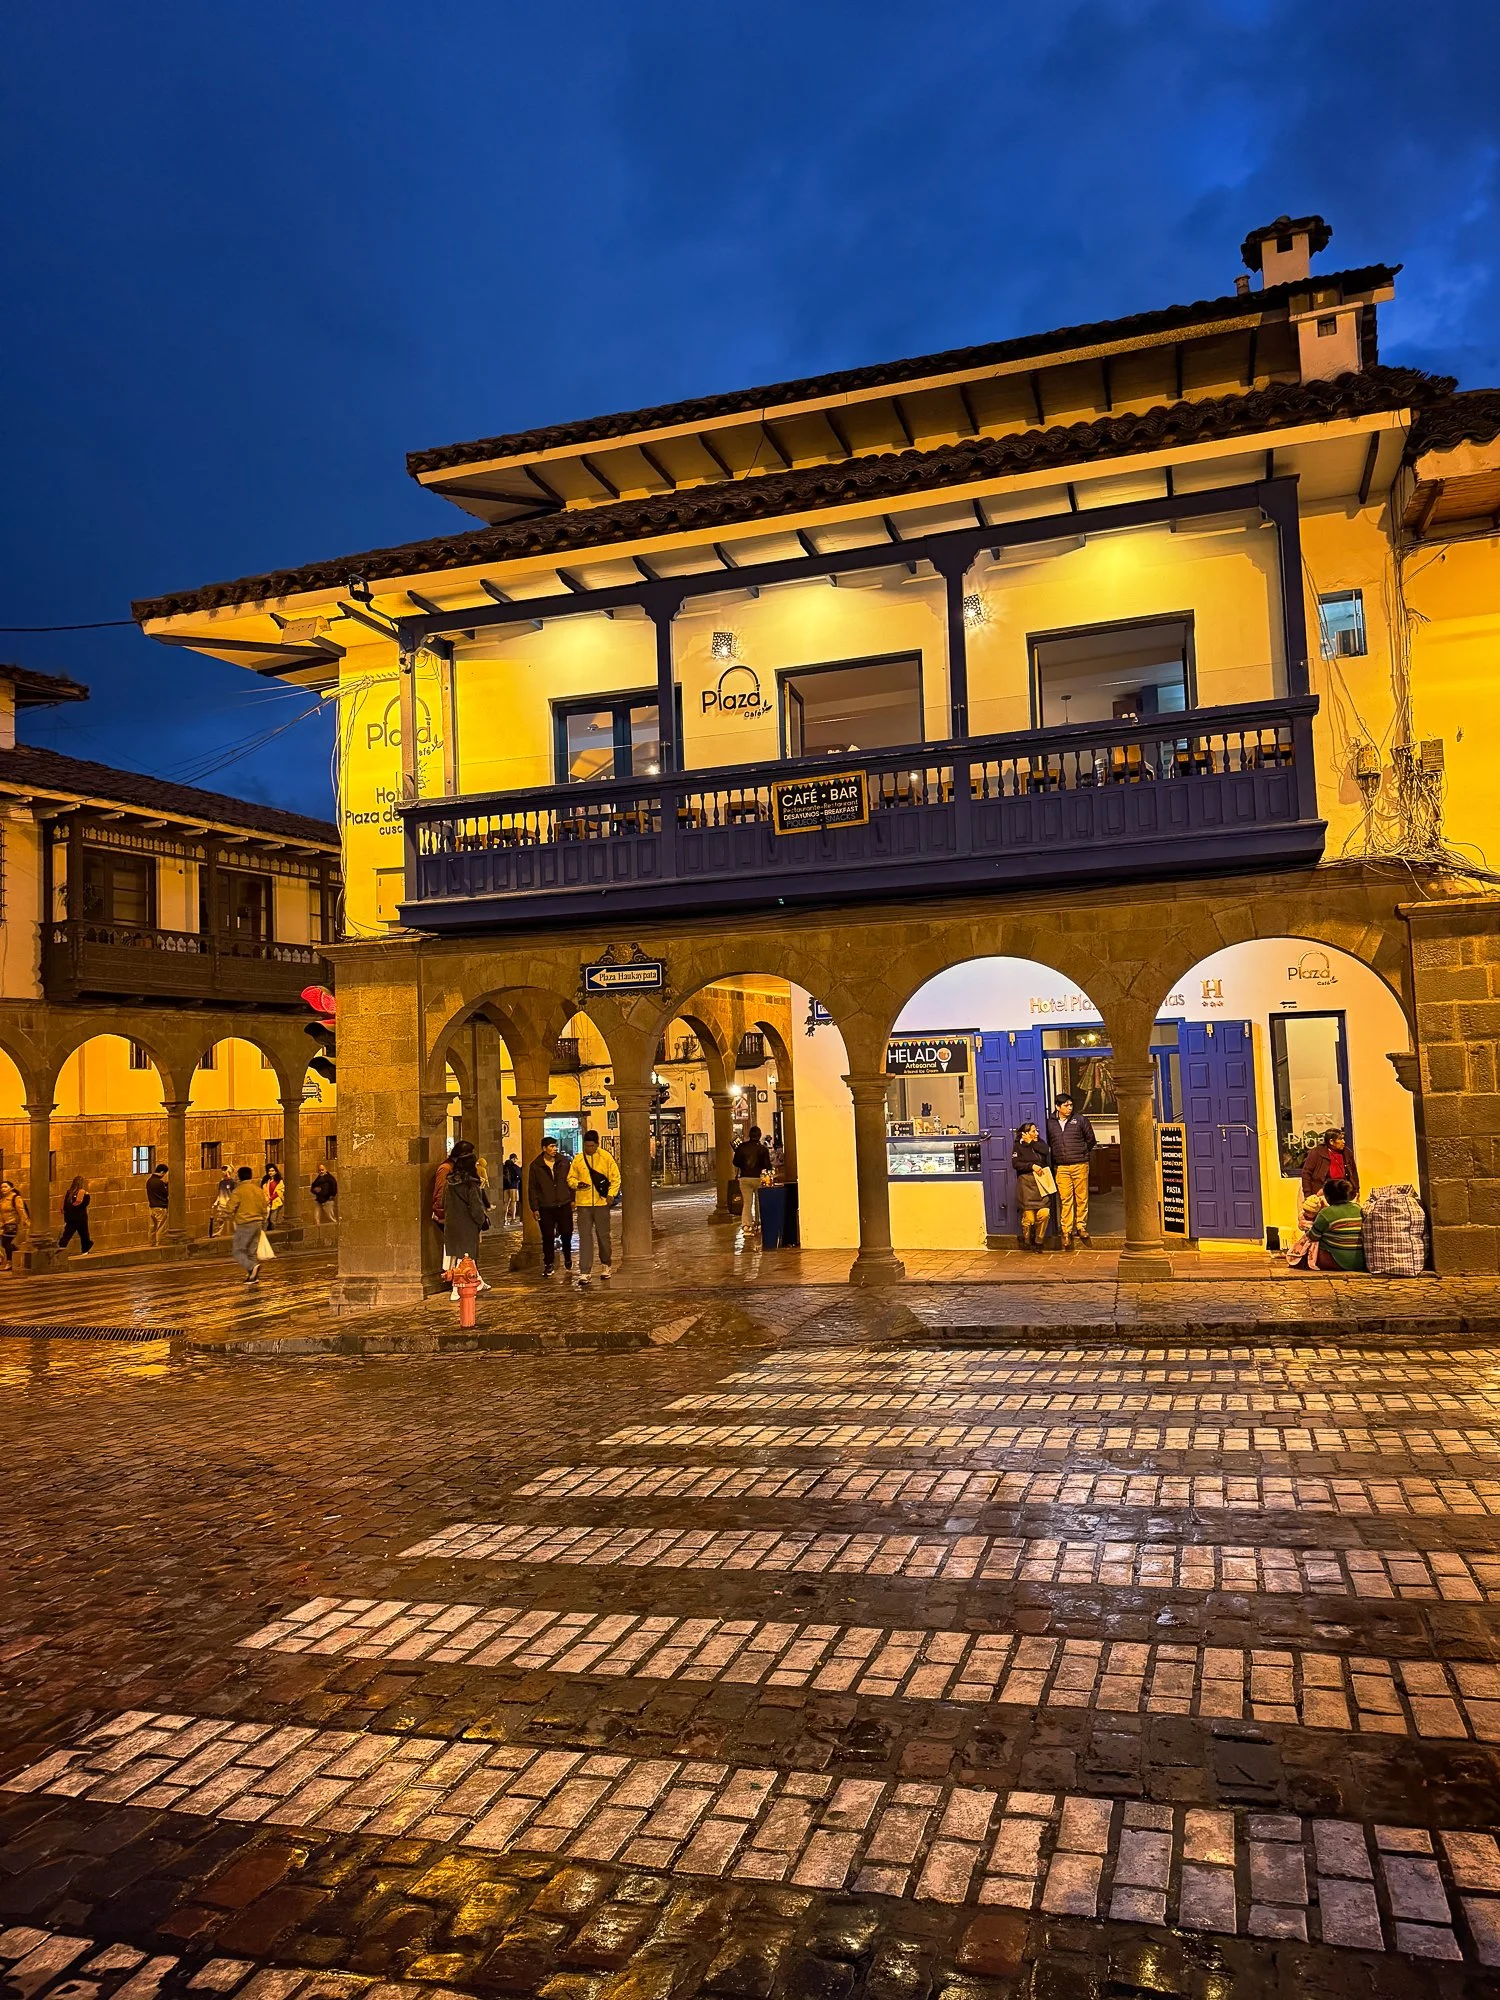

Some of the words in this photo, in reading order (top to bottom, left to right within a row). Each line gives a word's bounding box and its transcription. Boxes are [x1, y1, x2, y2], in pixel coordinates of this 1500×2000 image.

[702, 688, 760, 713] Plaza
[744, 709, 761, 718] Café
[367, 718, 432, 749] Plaa
[418, 746, 432, 757] afé
[376, 787, 403, 804] Hot
[782, 789, 818, 807] CAFÉ
[830, 786, 858, 800] BAR
[345, 808, 380, 826] Plaza
[783, 811, 820, 820] DESAYUNOS
[824, 806, 858, 816] BREAKFAST
[786, 818, 818, 828] PIQUEOS
[825, 813, 856, 823] SNACKS
[379, 825, 403, 836] CUSC
[599, 973, 616, 982] Plaza
[1288, 967, 1330, 980] Plaza
[1200, 979, 1224, 999] H
[1029, 995, 1067, 1013] Hotel
[1071, 994, 1096, 1012] Pla
[888, 1047, 952, 1063] HELADO
[1166, 1185, 1181, 1194] PASTA
